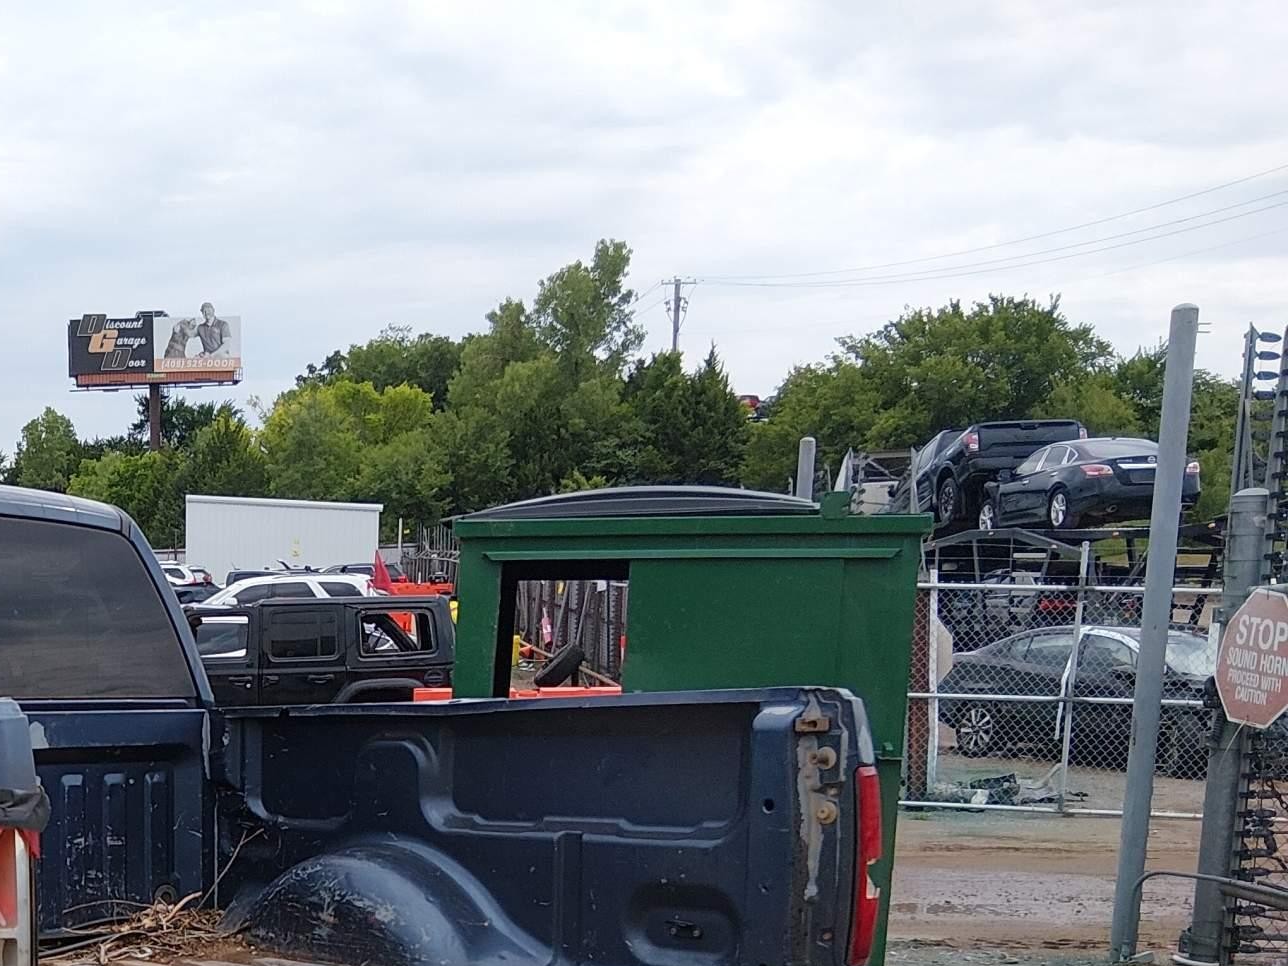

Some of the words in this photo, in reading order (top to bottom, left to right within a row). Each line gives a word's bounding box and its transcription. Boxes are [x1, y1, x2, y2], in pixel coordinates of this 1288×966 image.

[77, 314, 143, 336] Discount
[88, 329, 146, 353] Garage
[101, 347, 146, 371] Door
[1235, 614, 1288, 651] STOP
[1226, 647, 1258, 670] SOUND
[1259, 654, 1288, 677] HORN
[1227, 668, 1260, 688] PROCEED
[1260, 675, 1282, 693] WITH
[1235, 685, 1267, 705] CAUTION
